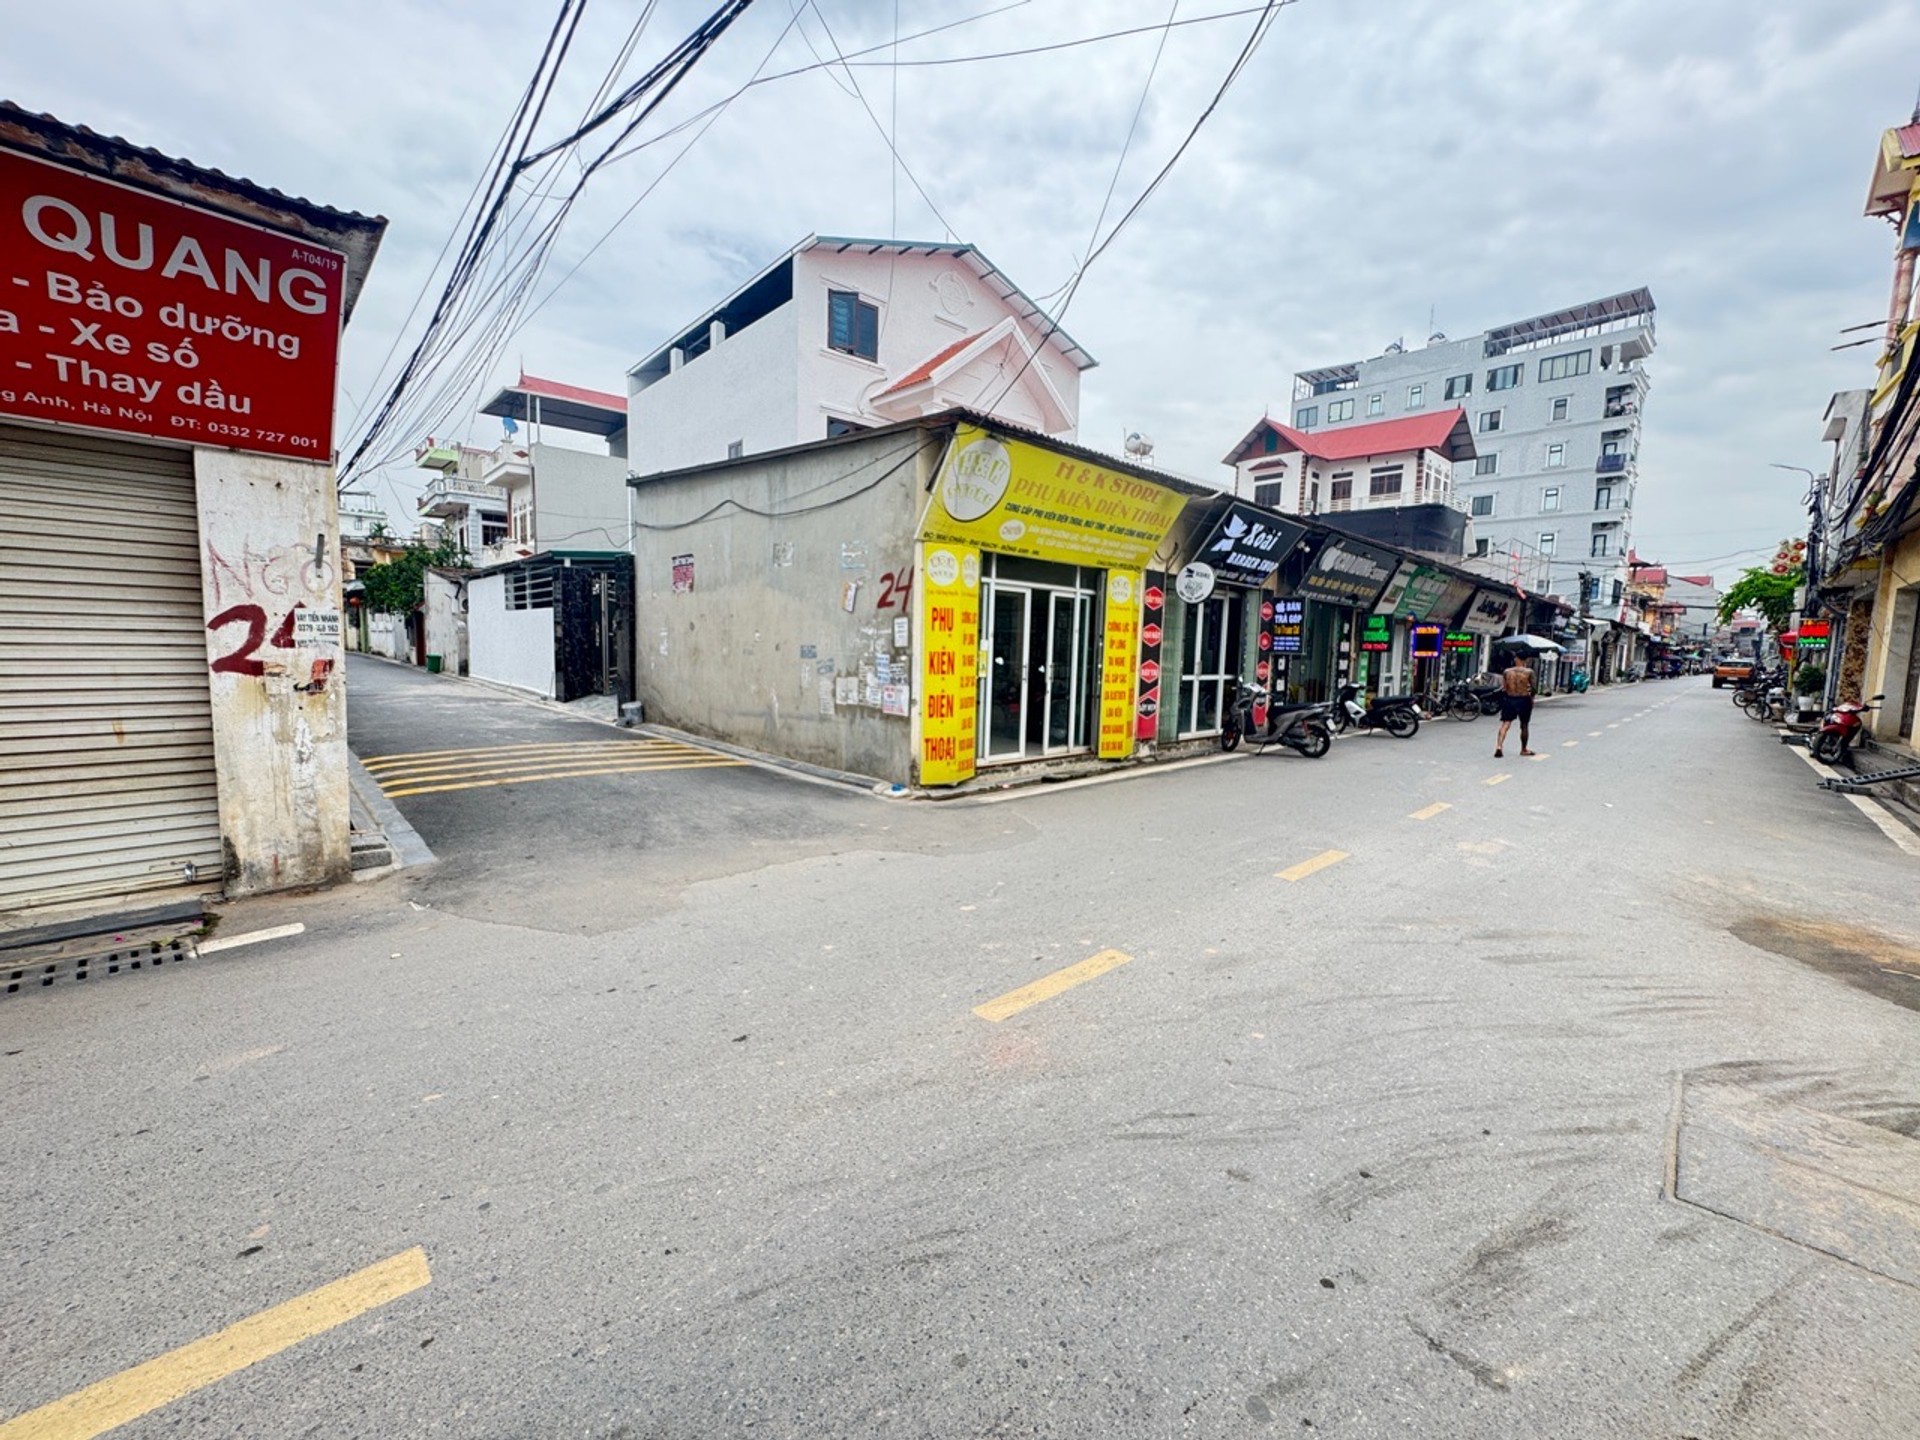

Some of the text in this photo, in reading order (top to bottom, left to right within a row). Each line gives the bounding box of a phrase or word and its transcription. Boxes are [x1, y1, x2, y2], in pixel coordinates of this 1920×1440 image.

[22, 194, 328, 315] QUANG
[291, 248, 338, 271] A-T04/19
[46, 271, 144, 319] Bảo
[159, 302, 300, 360] dưỡng
[70, 318, 131, 356] Xe
[146, 336, 200, 369] số
[46, 353, 162, 403] Thay
[176, 379, 252, 415] dầu
[83, 400, 112, 416] Hà
[119, 408, 153, 423] Nội
[170, 415, 201, 431] ĐT:
[207, 421, 251, 439] 0332
[255, 429, 286, 443] 727
[290, 435, 318, 449] 001
[1241, 522, 1282, 551] Xoài
[1226, 551, 1261, 570] BARBER
[877, 565, 914, 614] 24
[931, 607, 955, 638] PHỤ
[928, 646, 955, 681] KIỆN
[928, 689, 954, 724] ĐIỆN
[924, 737, 956, 766] THOẠI
